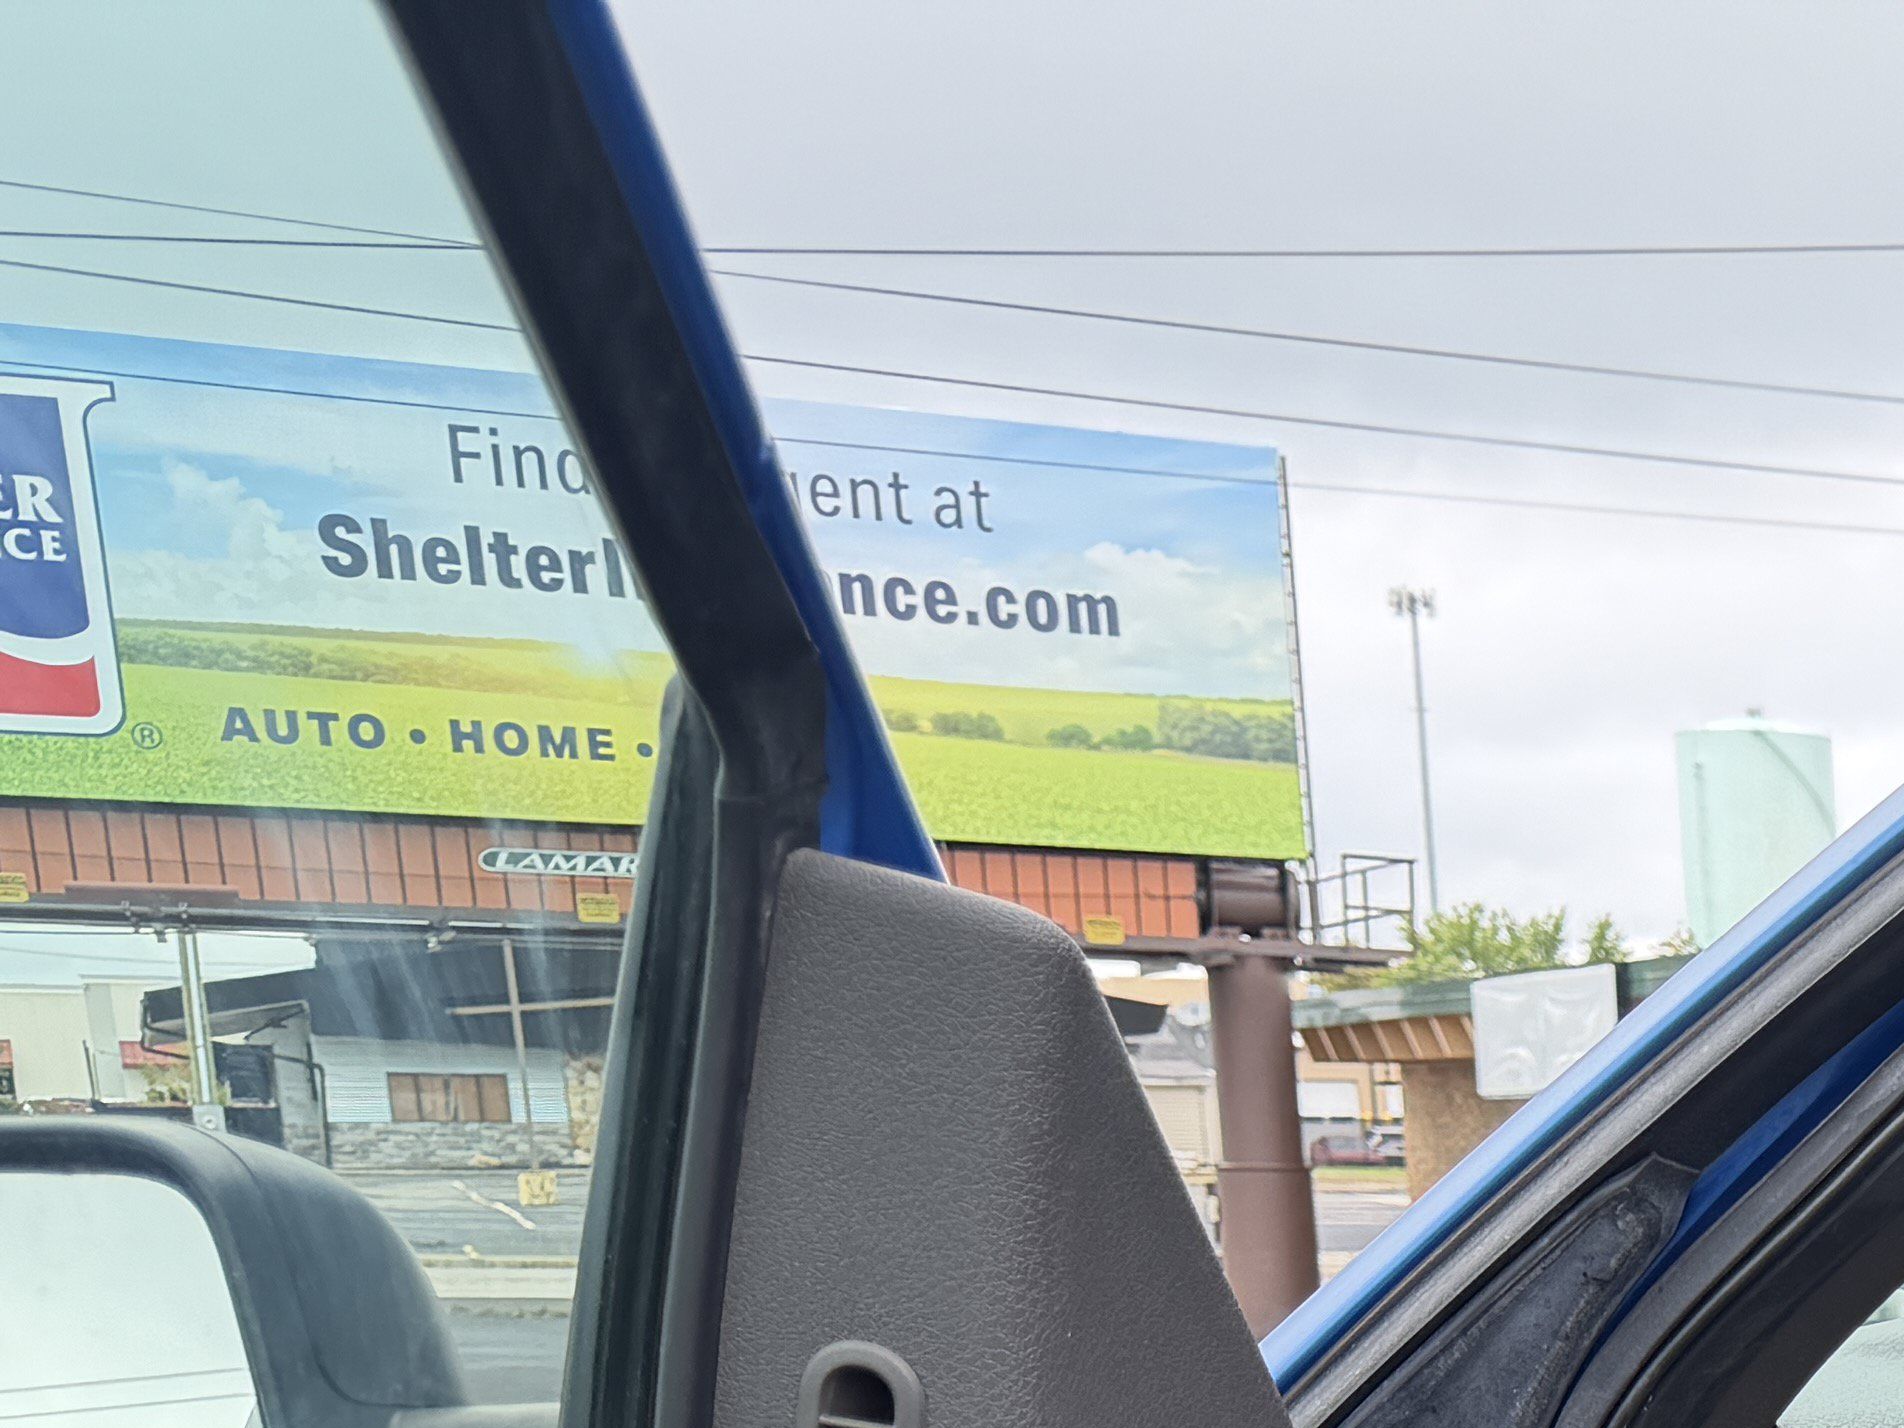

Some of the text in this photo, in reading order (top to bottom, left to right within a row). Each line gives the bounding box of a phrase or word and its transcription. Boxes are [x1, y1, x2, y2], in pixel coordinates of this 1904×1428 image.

[790, 472, 913, 525] ent
[934, 480, 993, 532] at
[221, 706, 616, 762] AUTO HOME
